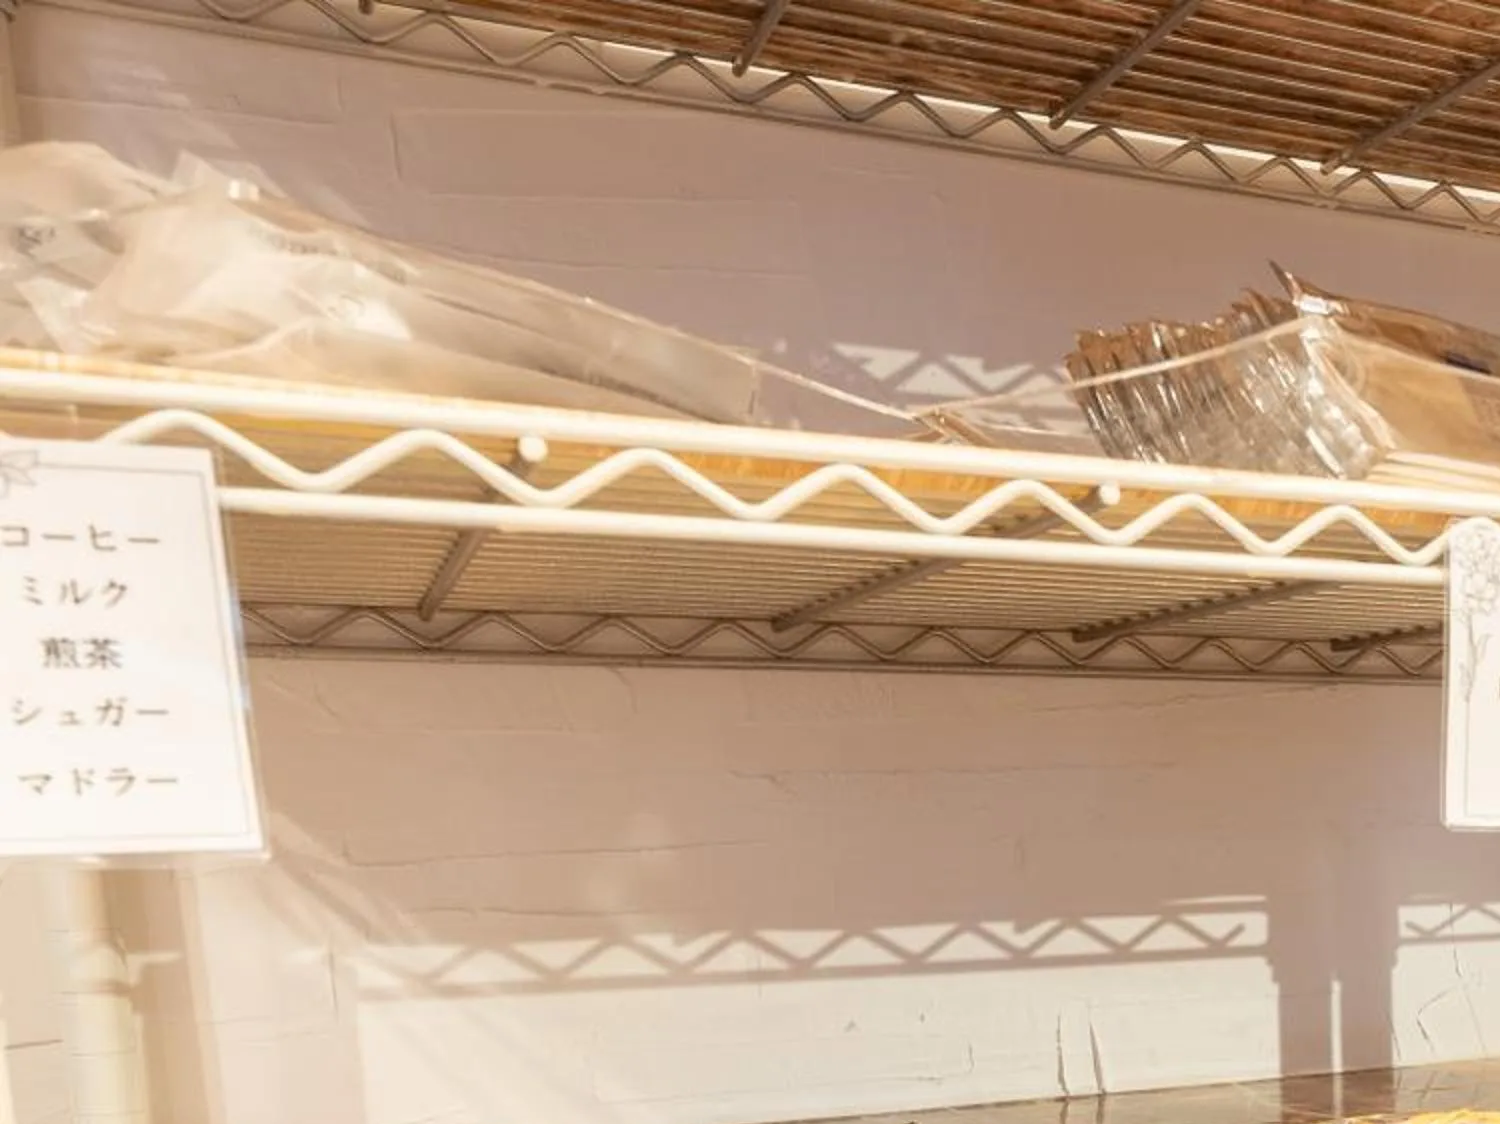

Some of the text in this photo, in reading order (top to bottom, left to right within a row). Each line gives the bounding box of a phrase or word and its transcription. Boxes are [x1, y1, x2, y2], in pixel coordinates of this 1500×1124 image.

[1, 524, 161, 552] コーヒー
[23, 576, 128, 607] ミルク
[40, 636, 123, 670] 煎茶
[12, 697, 169, 727] シュガー
[18, 767, 178, 797] マドラー
